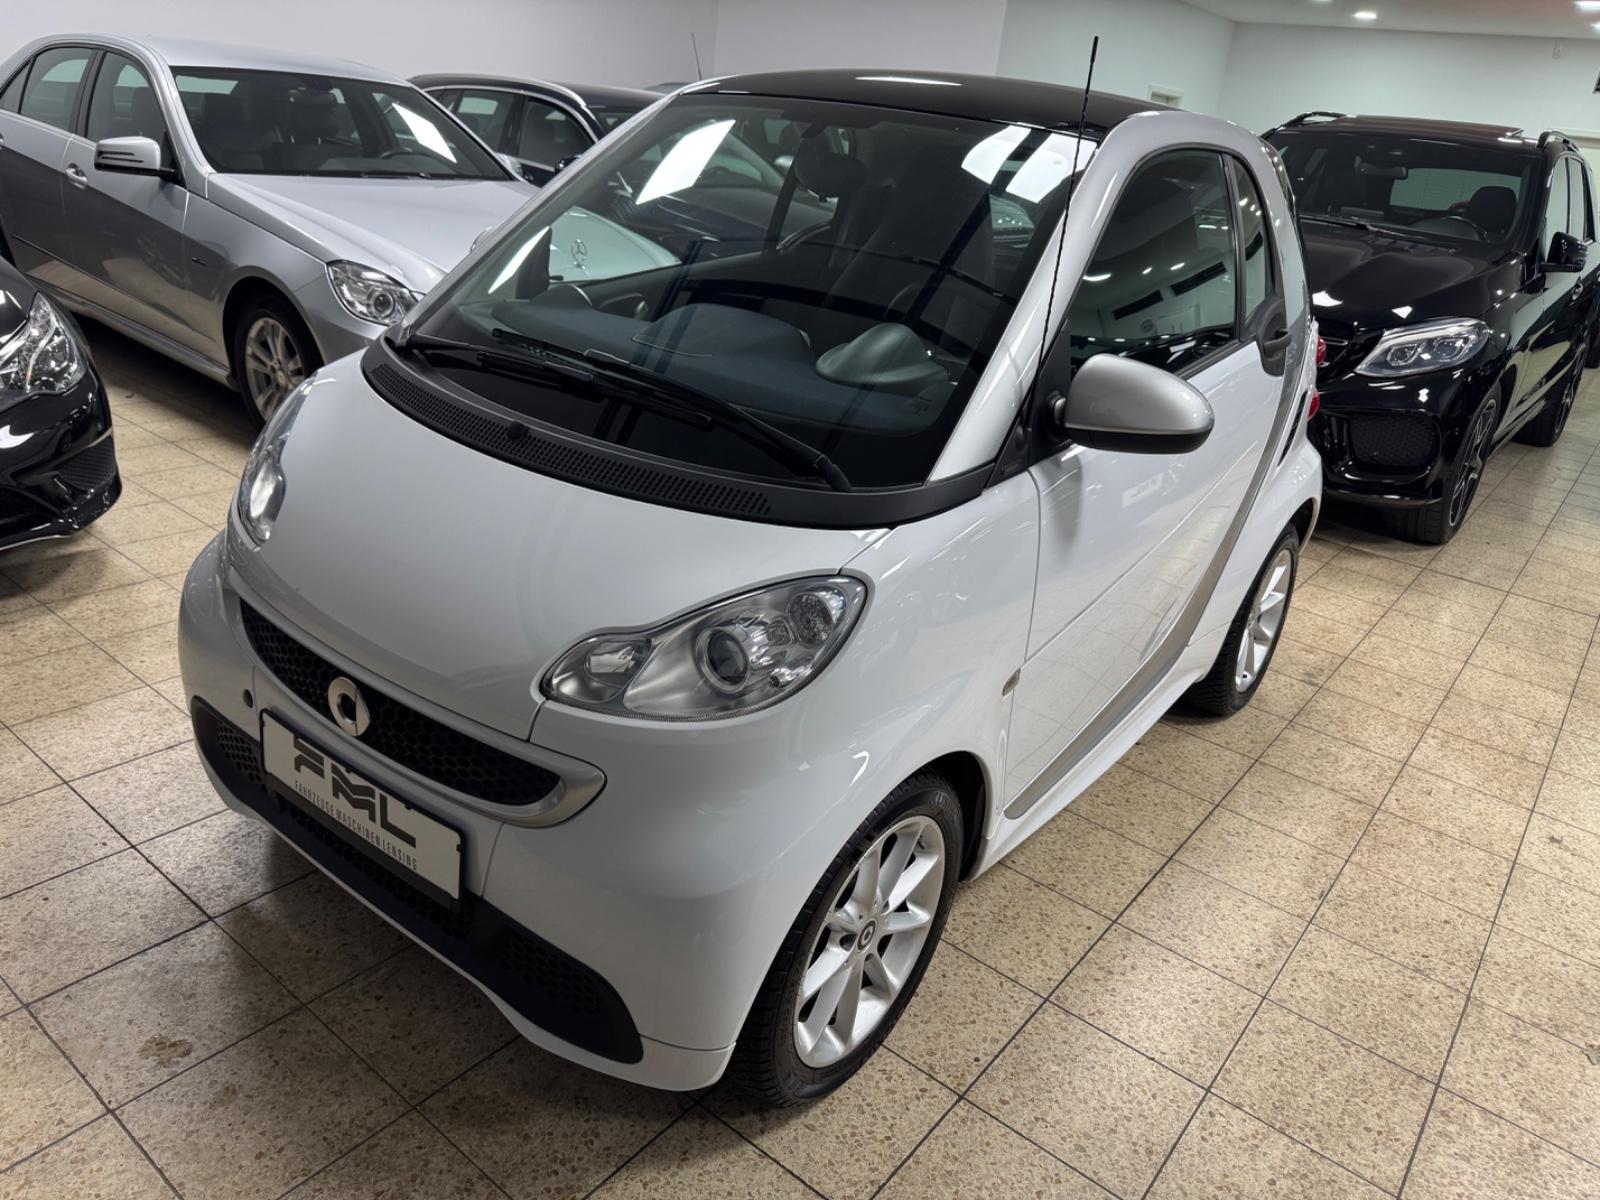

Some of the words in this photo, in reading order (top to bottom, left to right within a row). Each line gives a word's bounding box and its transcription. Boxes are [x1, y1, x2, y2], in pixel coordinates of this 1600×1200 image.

[293, 733, 417, 849] FML
[294, 779, 334, 816] FAHRZEUGE
[335, 808, 381, 846] MASCHINEN
[382, 836, 418, 871] LENSING
